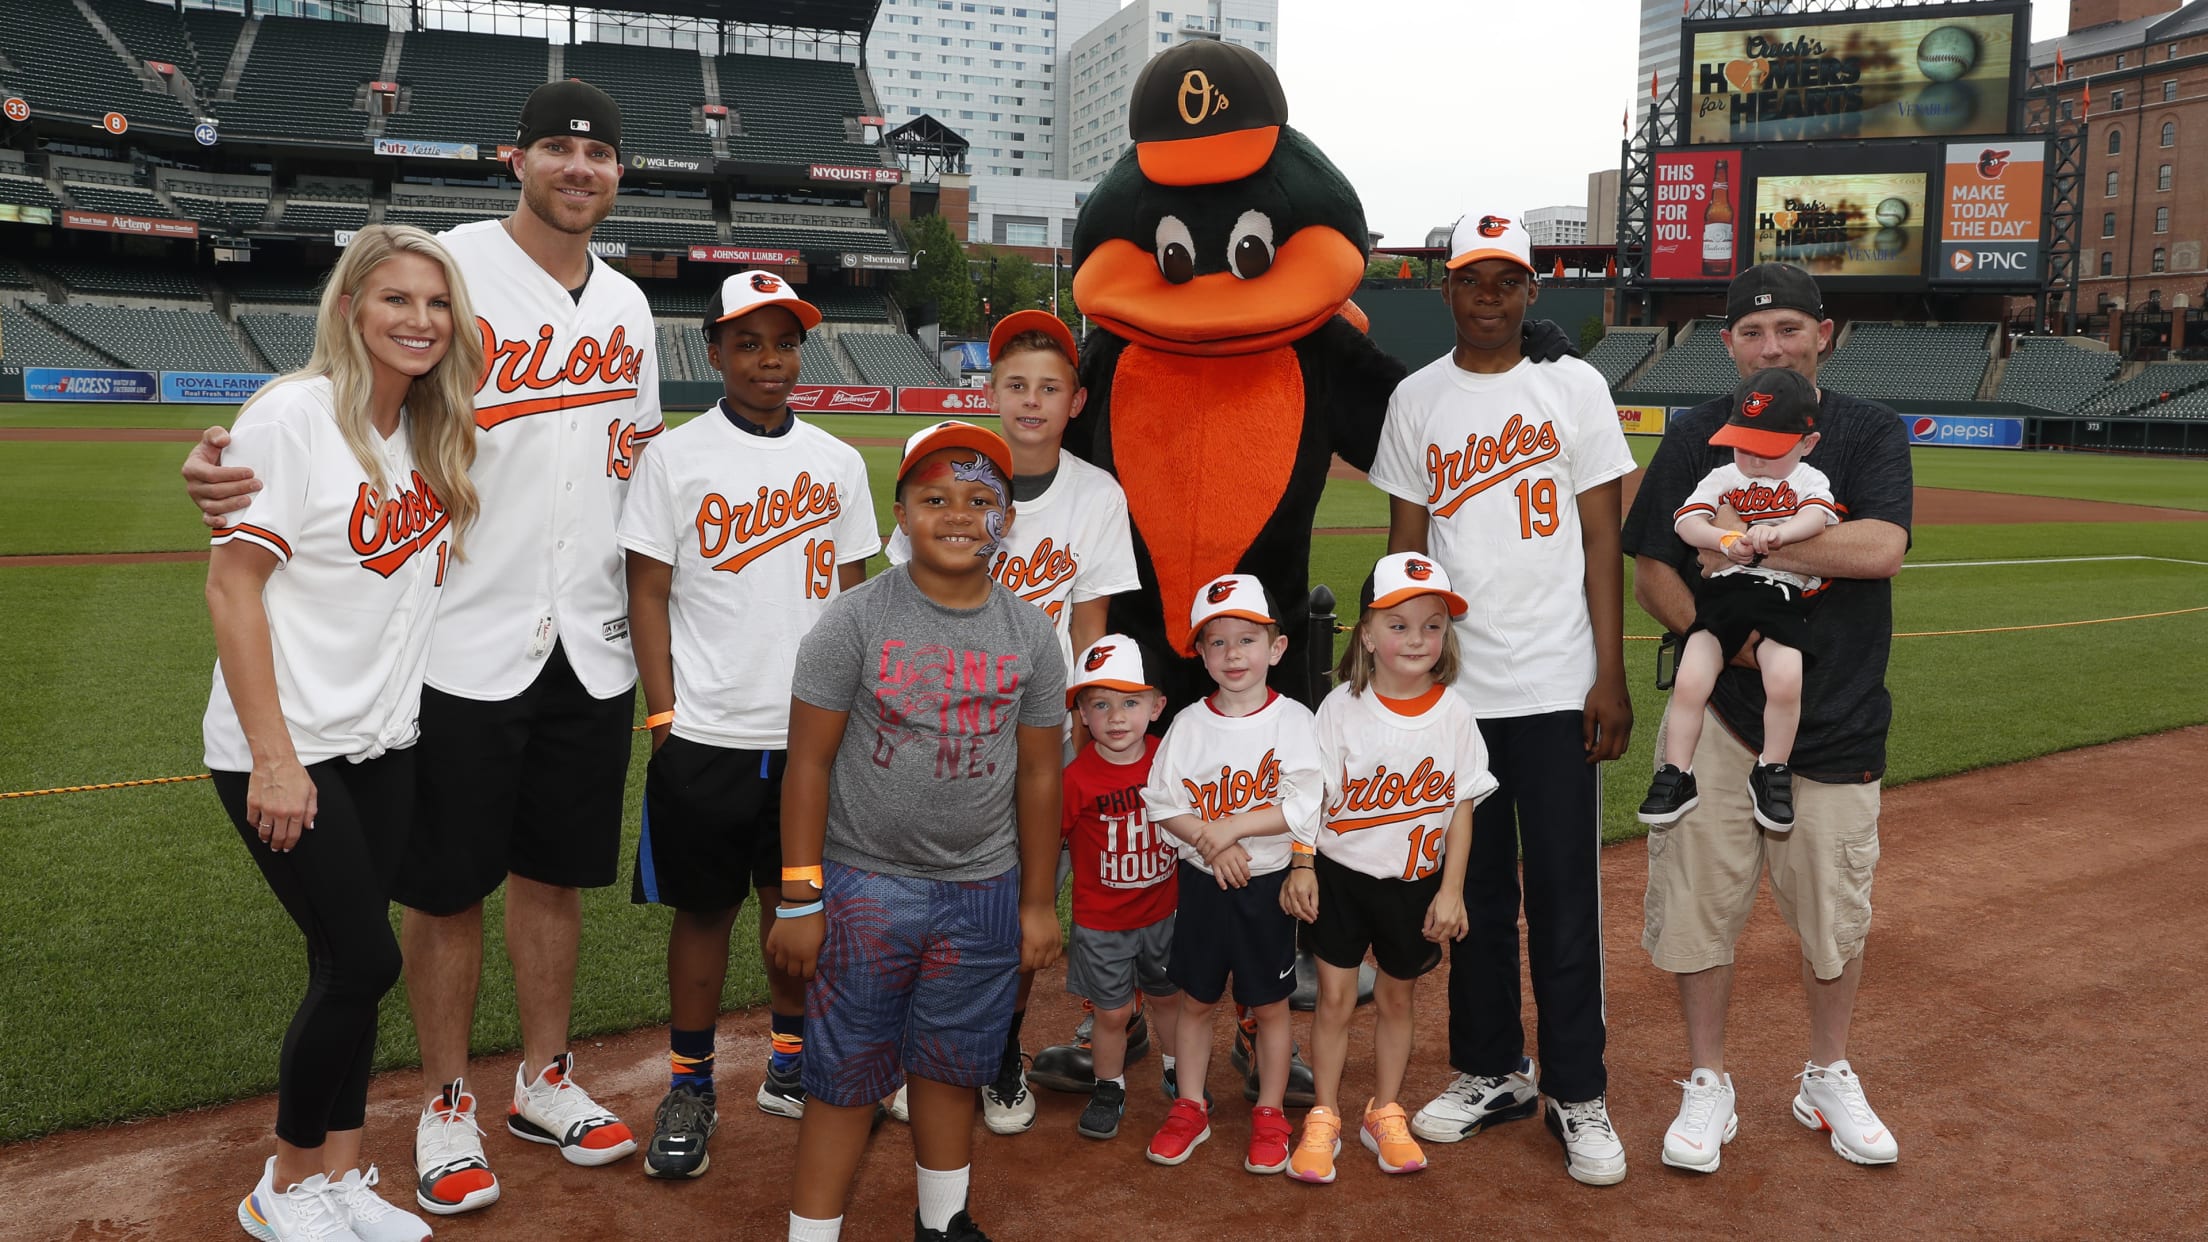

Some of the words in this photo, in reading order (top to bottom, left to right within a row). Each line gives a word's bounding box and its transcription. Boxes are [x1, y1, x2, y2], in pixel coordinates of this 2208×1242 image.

[1746, 35, 1827, 58] Crush's
[1178, 70, 1230, 125] O's
[8, 103, 26, 117] 33
[1700, 97, 1726, 118] for
[112, 118, 121, 129] 8
[197, 128, 214, 141] 42
[646, 158, 667, 167] WGL
[668, 159, 699, 170] Energy
[1658, 164, 1694, 181] THIS
[813, 167, 869, 180] NYQUIST
[1657, 184, 1706, 201] BUD'S
[1952, 185, 2006, 201] MAKE
[1656, 204, 1687, 221] FOR
[1951, 203, 2010, 218] TODAY
[112, 217, 151, 231] Airtemp
[1655, 224, 1692, 240] YOU.
[1950, 221, 1985, 236] THE
[712, 250, 750, 260] JOHNSON
[752, 251, 783, 261] LUMBER
[863, 254, 905, 264] Sheraton
[1976, 251, 2027, 270] PNC
[2, 367, 20, 375] 333
[66, 377, 111, 393] ACCESS
[834, 393, 876, 403] Budweiser
[964, 394, 990, 409] Sta
[1941, 423, 1994, 440] pepsi
[607, 418, 637, 481] 19
[1426, 413, 1560, 504] Orioles
[1719, 480, 1798, 512] riole
[348, 470, 445, 556] Oriol
[695, 471, 841, 558] Orioles
[1514, 478, 1559, 540] 19
[804, 538, 836, 599] 19
[986, 537, 1077, 593] ioles
[1181, 748, 1281, 823] riols
[1100, 808, 1161, 852] TH
[1402, 825, 1443, 880] 19
